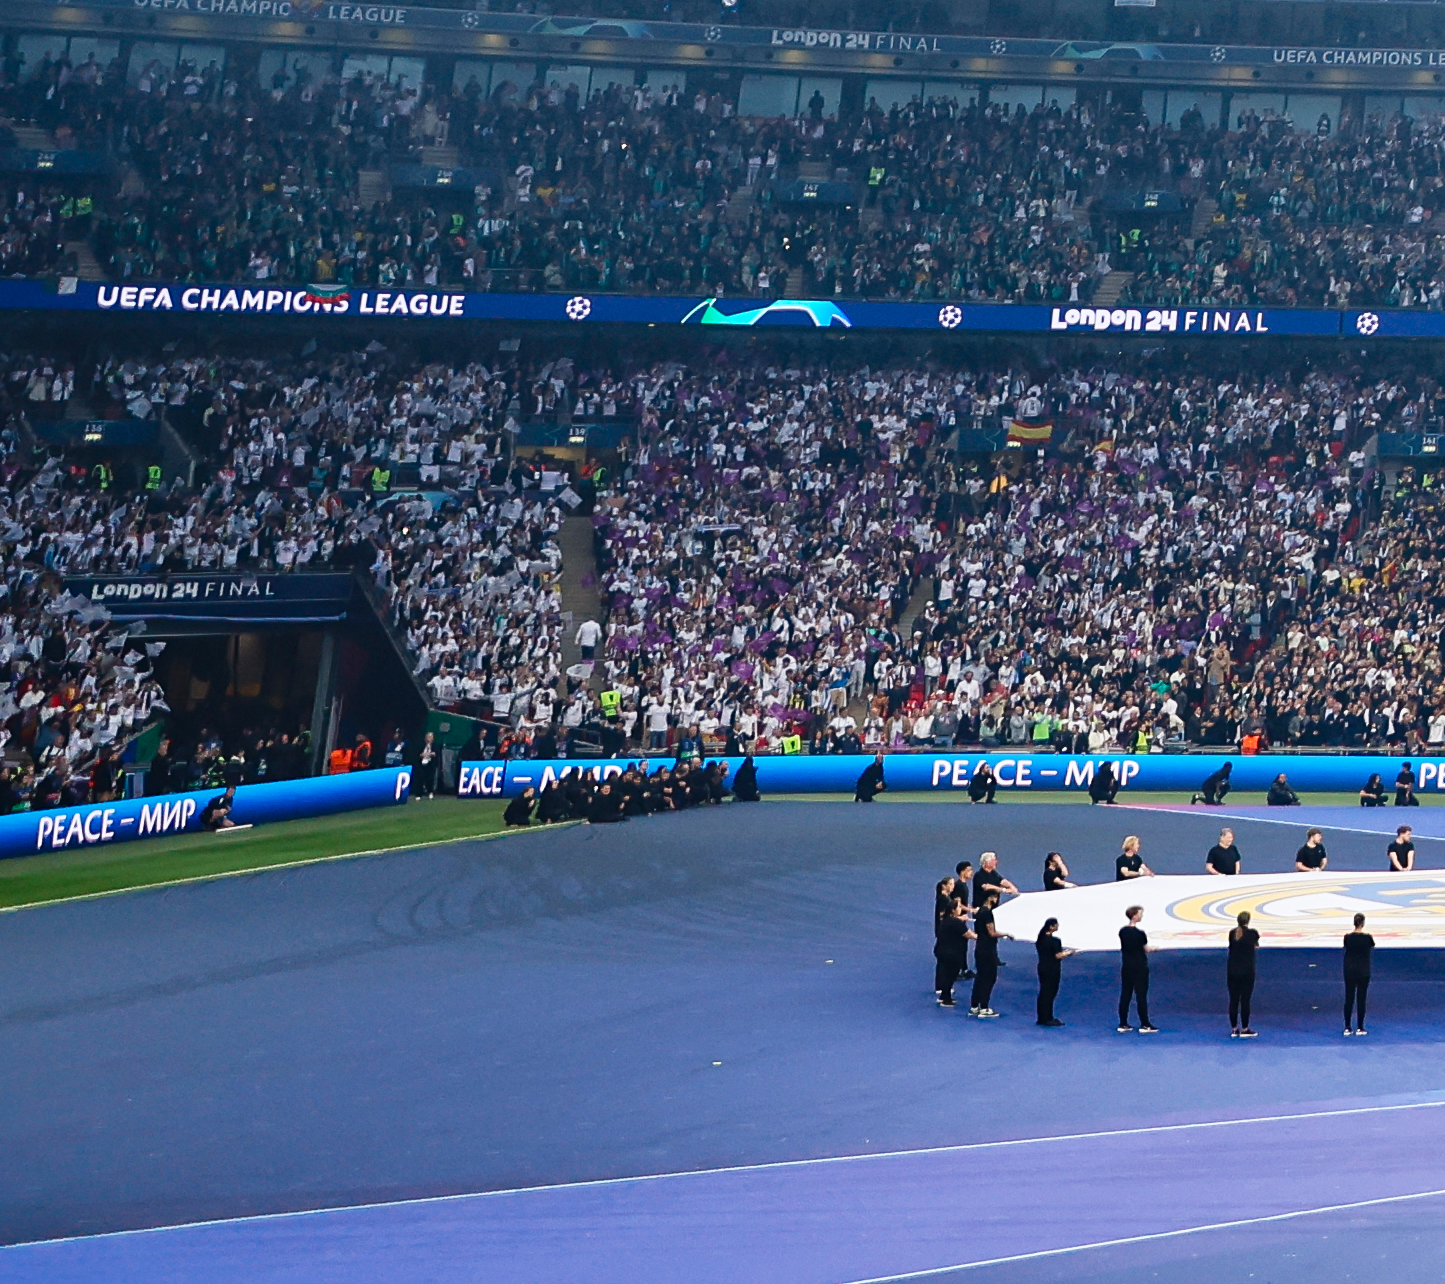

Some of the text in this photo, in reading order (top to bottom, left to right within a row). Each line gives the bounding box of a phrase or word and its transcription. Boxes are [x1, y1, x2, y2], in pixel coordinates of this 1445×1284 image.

[328, 5, 407, 24] LEAGUE
[845, 31, 870, 48] 24
[876, 33, 941, 52] FINAL
[1273, 48, 1317, 63] UEFA
[1321, 49, 1422, 66] CHAMPIONS
[97, 286, 172, 308] UEFA
[359, 293, 465, 315] LEAGUE
[1145, 309, 1178, 331] 24
[1185, 311, 1269, 332] FINAL
[172, 581, 199, 600] 24
[206, 580, 276, 596] FINAL
[37, 808, 115, 849] PEACE
